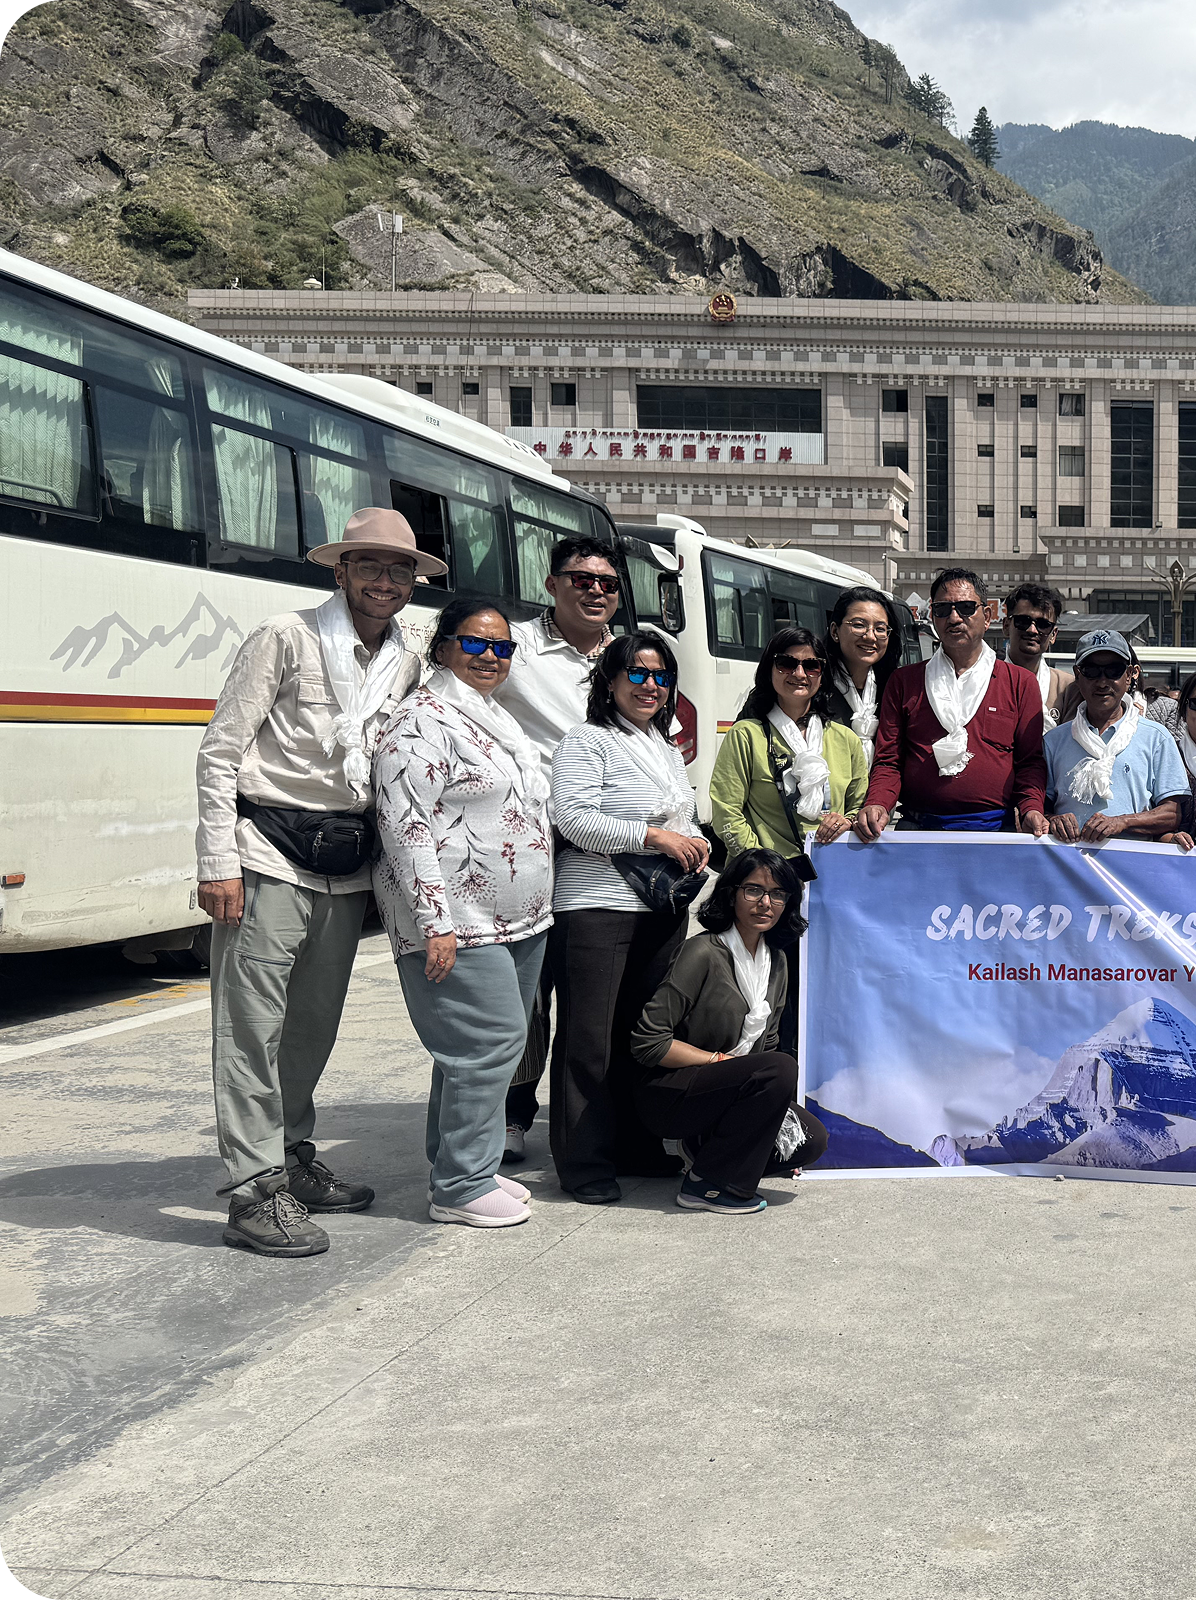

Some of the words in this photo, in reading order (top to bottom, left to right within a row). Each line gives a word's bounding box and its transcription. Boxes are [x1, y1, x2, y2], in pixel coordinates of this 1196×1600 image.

[534, 441, 792, 462] 中华人民共和国吉隆口岸
[926, 904, 1073, 941] SACRED
[968, 963, 1041, 981] Kailash
[1047, 964, 1178, 982] Manasarovar
